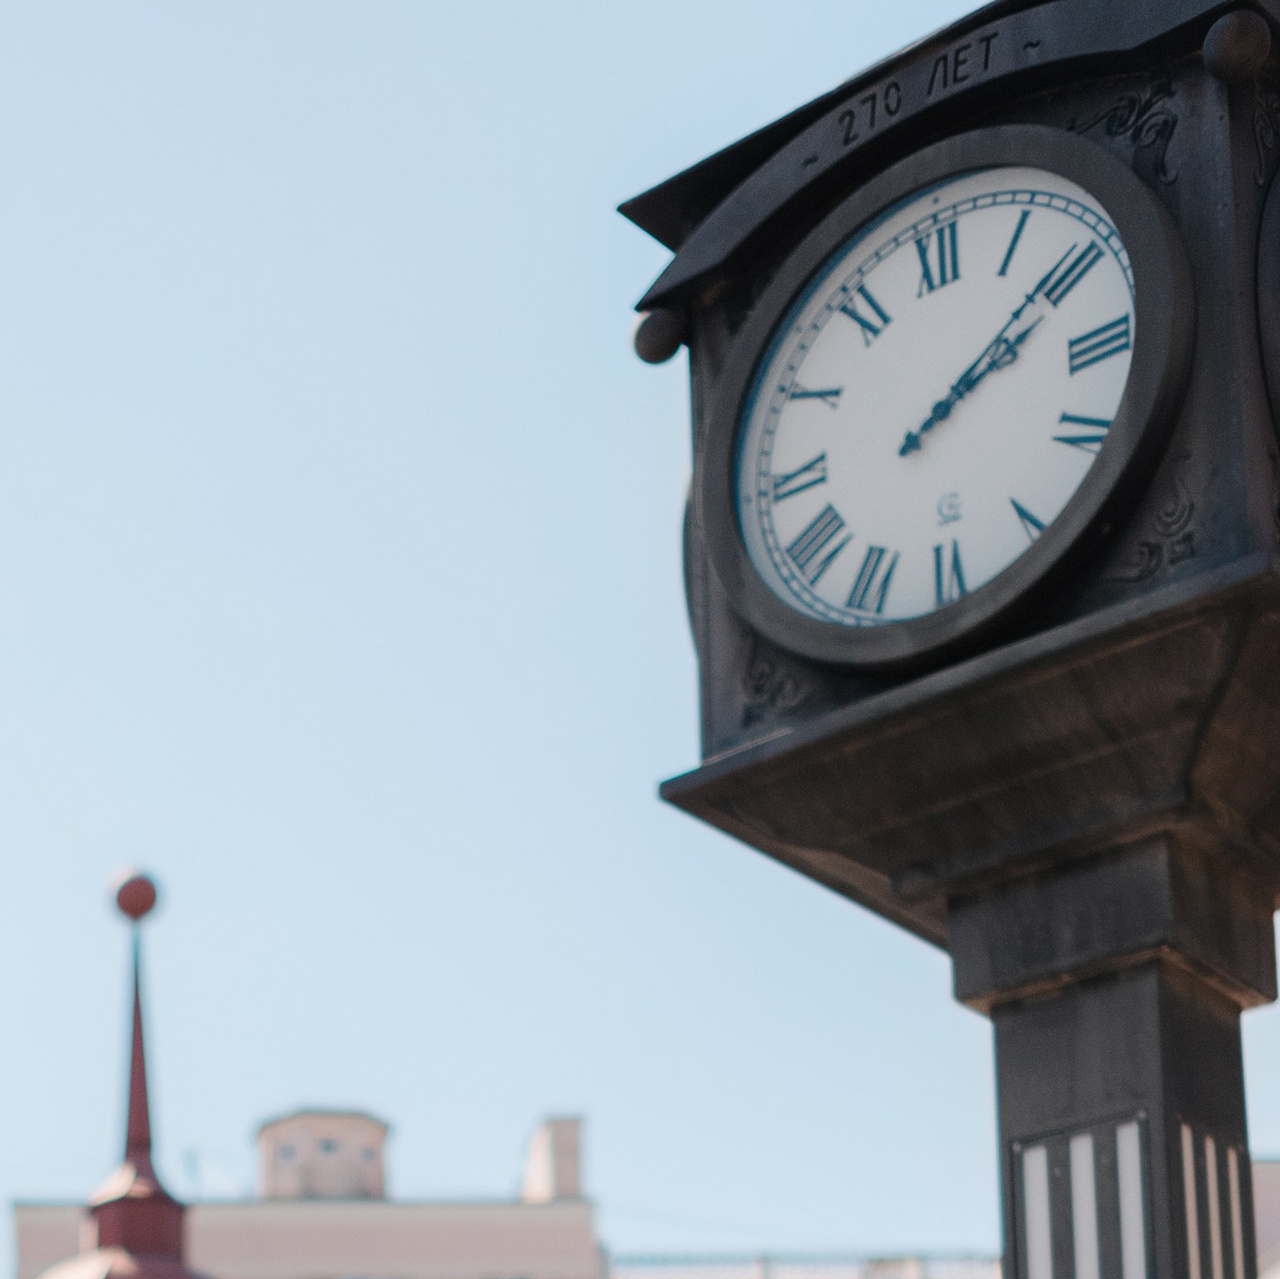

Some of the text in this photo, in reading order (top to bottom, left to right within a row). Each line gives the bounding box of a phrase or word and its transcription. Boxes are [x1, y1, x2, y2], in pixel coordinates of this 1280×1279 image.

[838, 32, 999, 147] 270 ЛЕТ
[916, 220, 961, 298] XII
[997, 210, 1032, 276] I
[1044, 240, 1106, 308] II
[839, 281, 892, 348] XI
[1068, 313, 1131, 376] III
[789, 380, 843, 408] X
[773, 451, 827, 502] IX
[786, 502, 854, 587] VIII
[845, 545, 900, 615] VII
